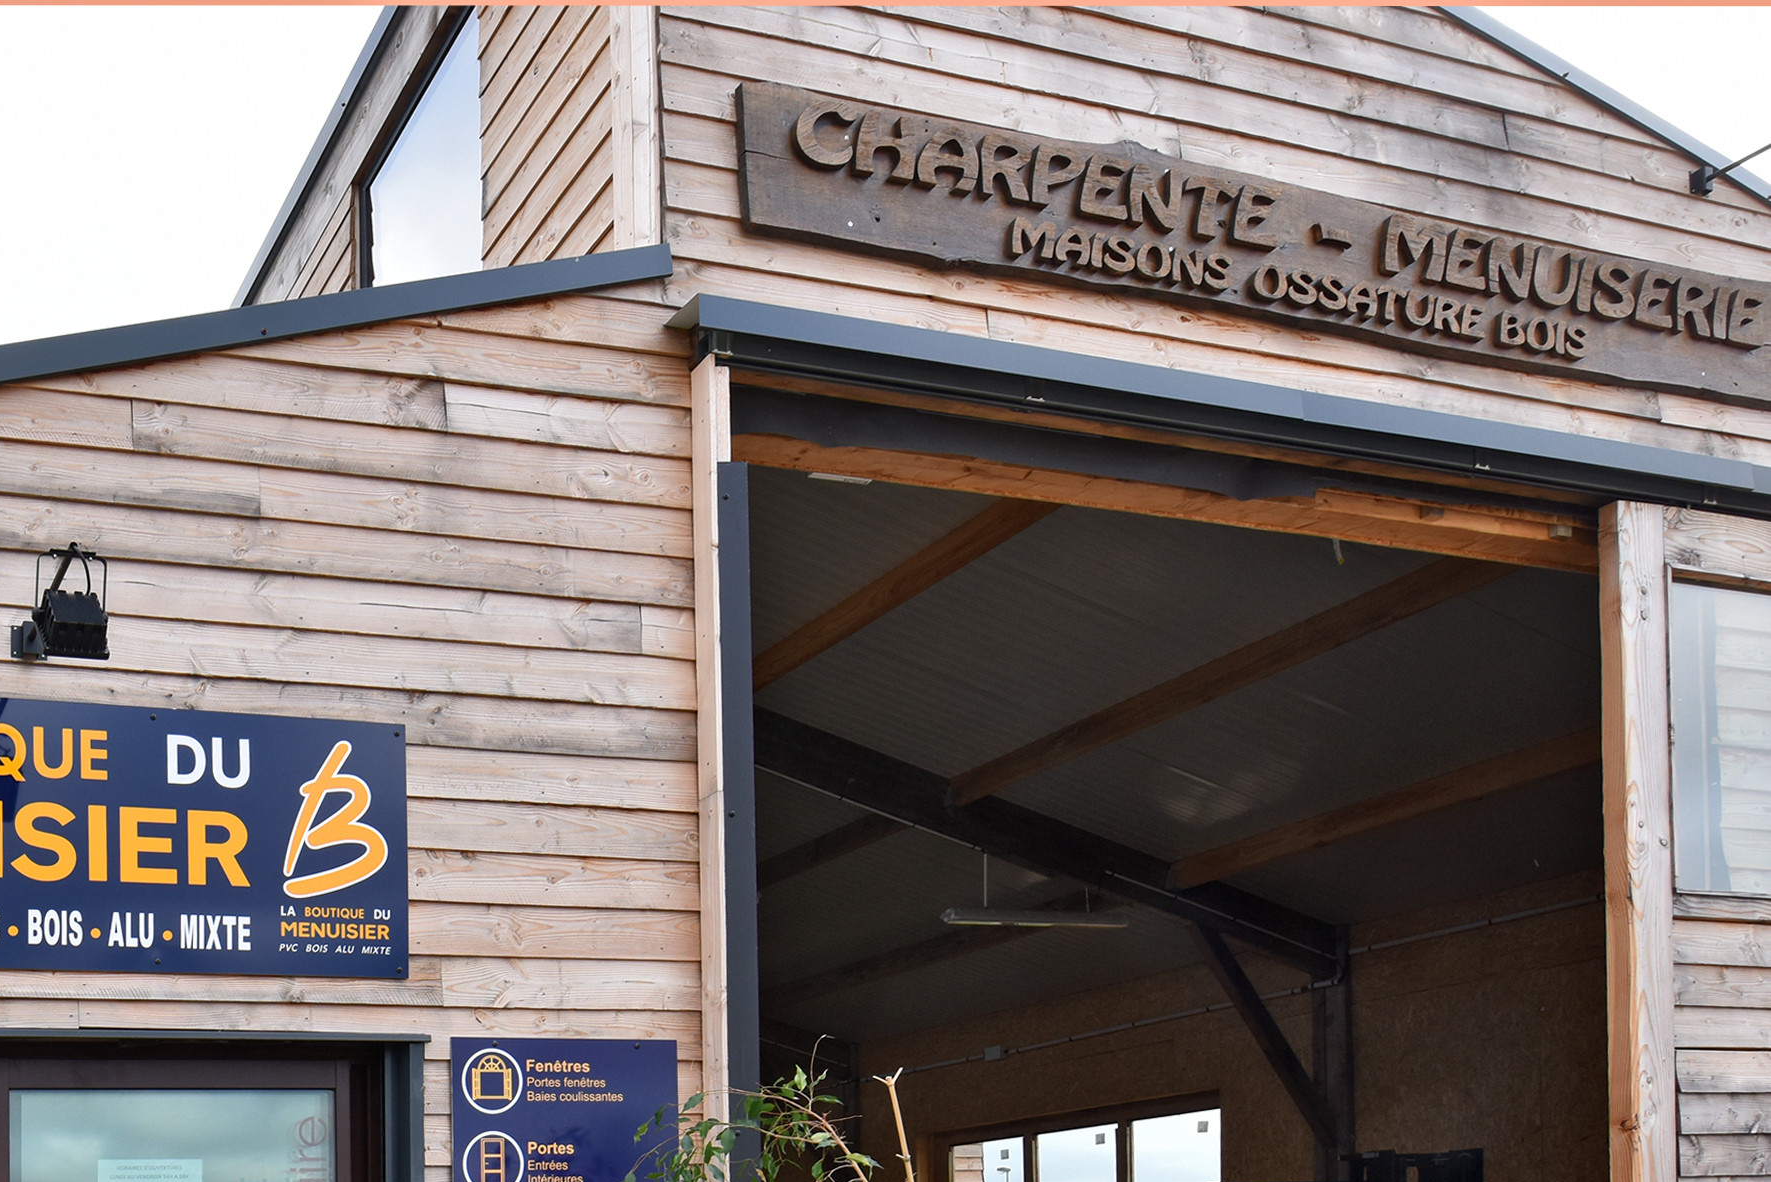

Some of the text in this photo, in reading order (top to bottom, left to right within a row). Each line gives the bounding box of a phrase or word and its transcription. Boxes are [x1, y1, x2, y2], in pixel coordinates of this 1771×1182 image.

[791, 98, 1283, 252] CHARPENTE
[1378, 212, 1769, 350] MENUISERIE
[1009, 214, 1590, 362] MAISONS OSSATURE BOIS
[167, 734, 252, 788] DU
[280, 905, 391, 921] LA BOUTIQUE DU
[28, 908, 83, 948] BOIS
[108, 911, 155, 950] ALU
[179, 914, 252, 954] MIXTE
[280, 921, 390, 940] MENUISIER
[279, 943, 392, 956] PVC BOIS ALU MIXTE
[526, 1059, 590, 1074] Fenêtres
[527, 1077, 606, 1088] Portes fenêtres
[527, 1091, 623, 1102] Baies coulissantes
[528, 1142, 574, 1155] Portes
[527, 1160, 568, 1171] Entrées
